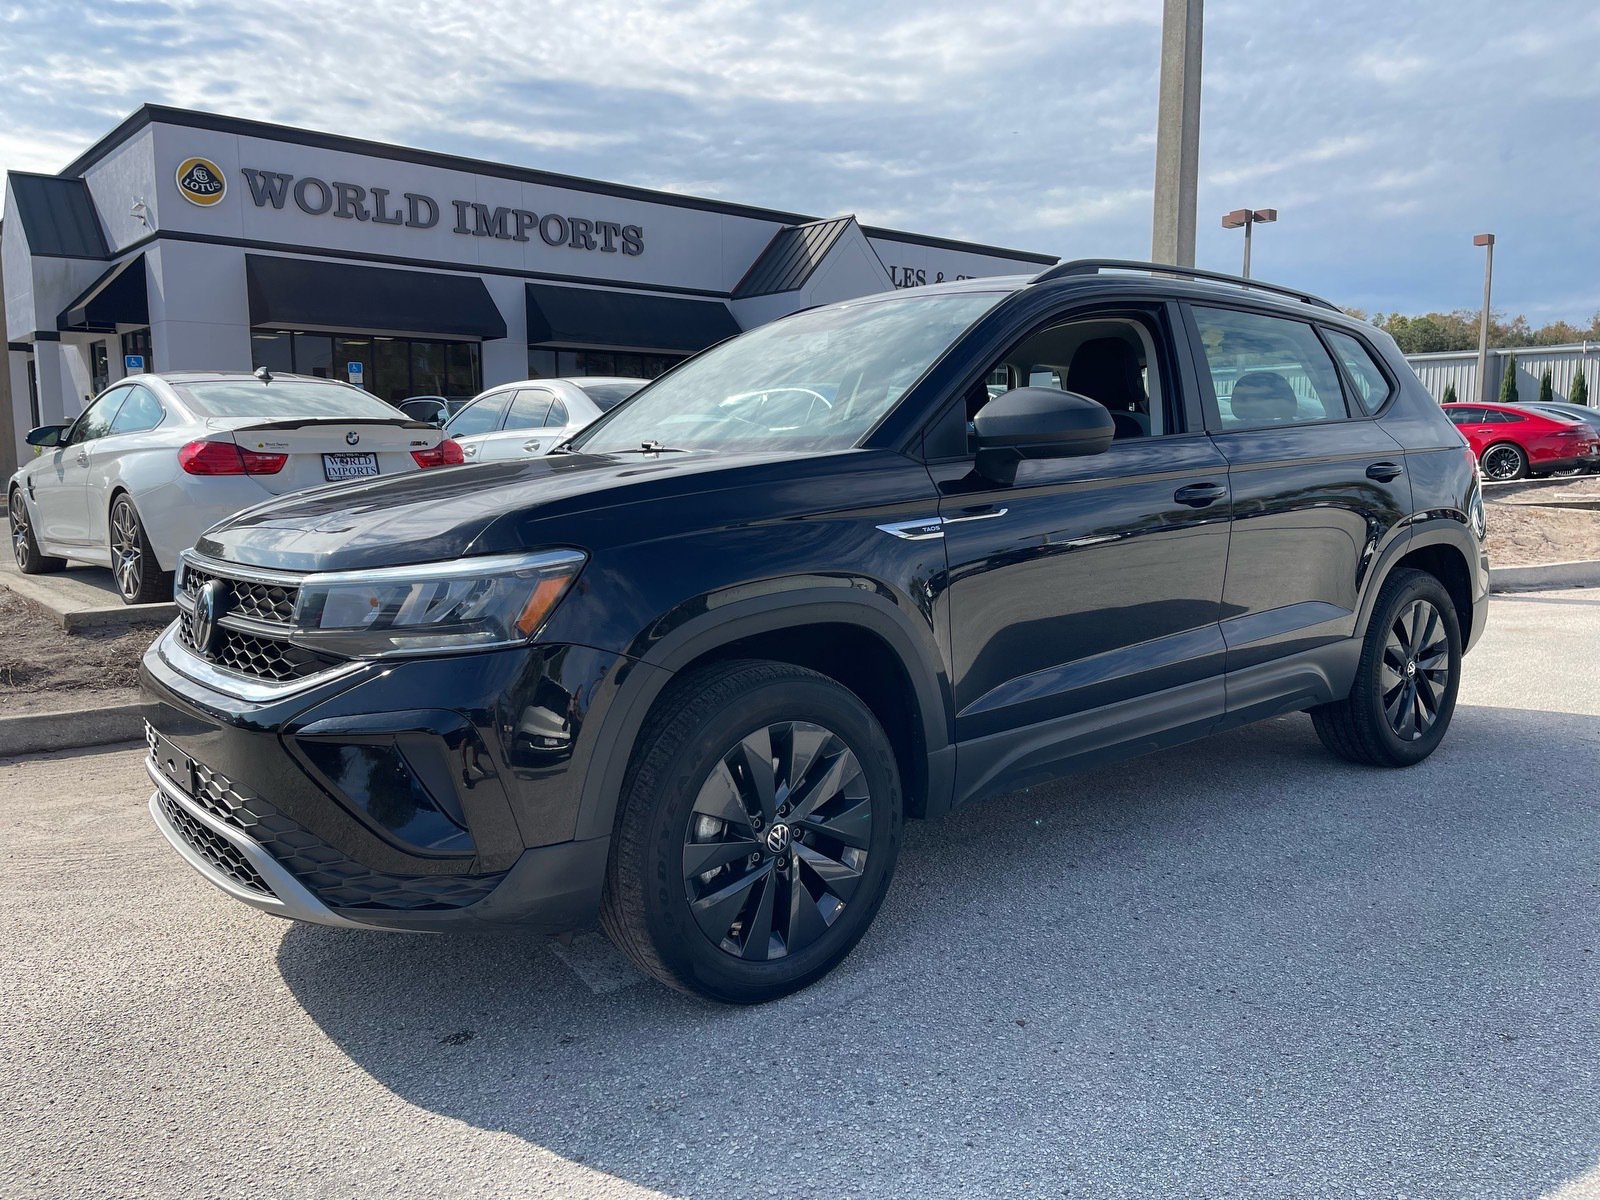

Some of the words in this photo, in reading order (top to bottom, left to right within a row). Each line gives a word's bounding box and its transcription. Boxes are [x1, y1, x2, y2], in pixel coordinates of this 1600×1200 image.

[183, 178, 221, 192] LOTUS
[241, 167, 440, 229] WORLD
[452, 199, 645, 257] IMPORTS
[328, 457, 372, 466] WORLD
[327, 466, 377, 476] IMPORTS
